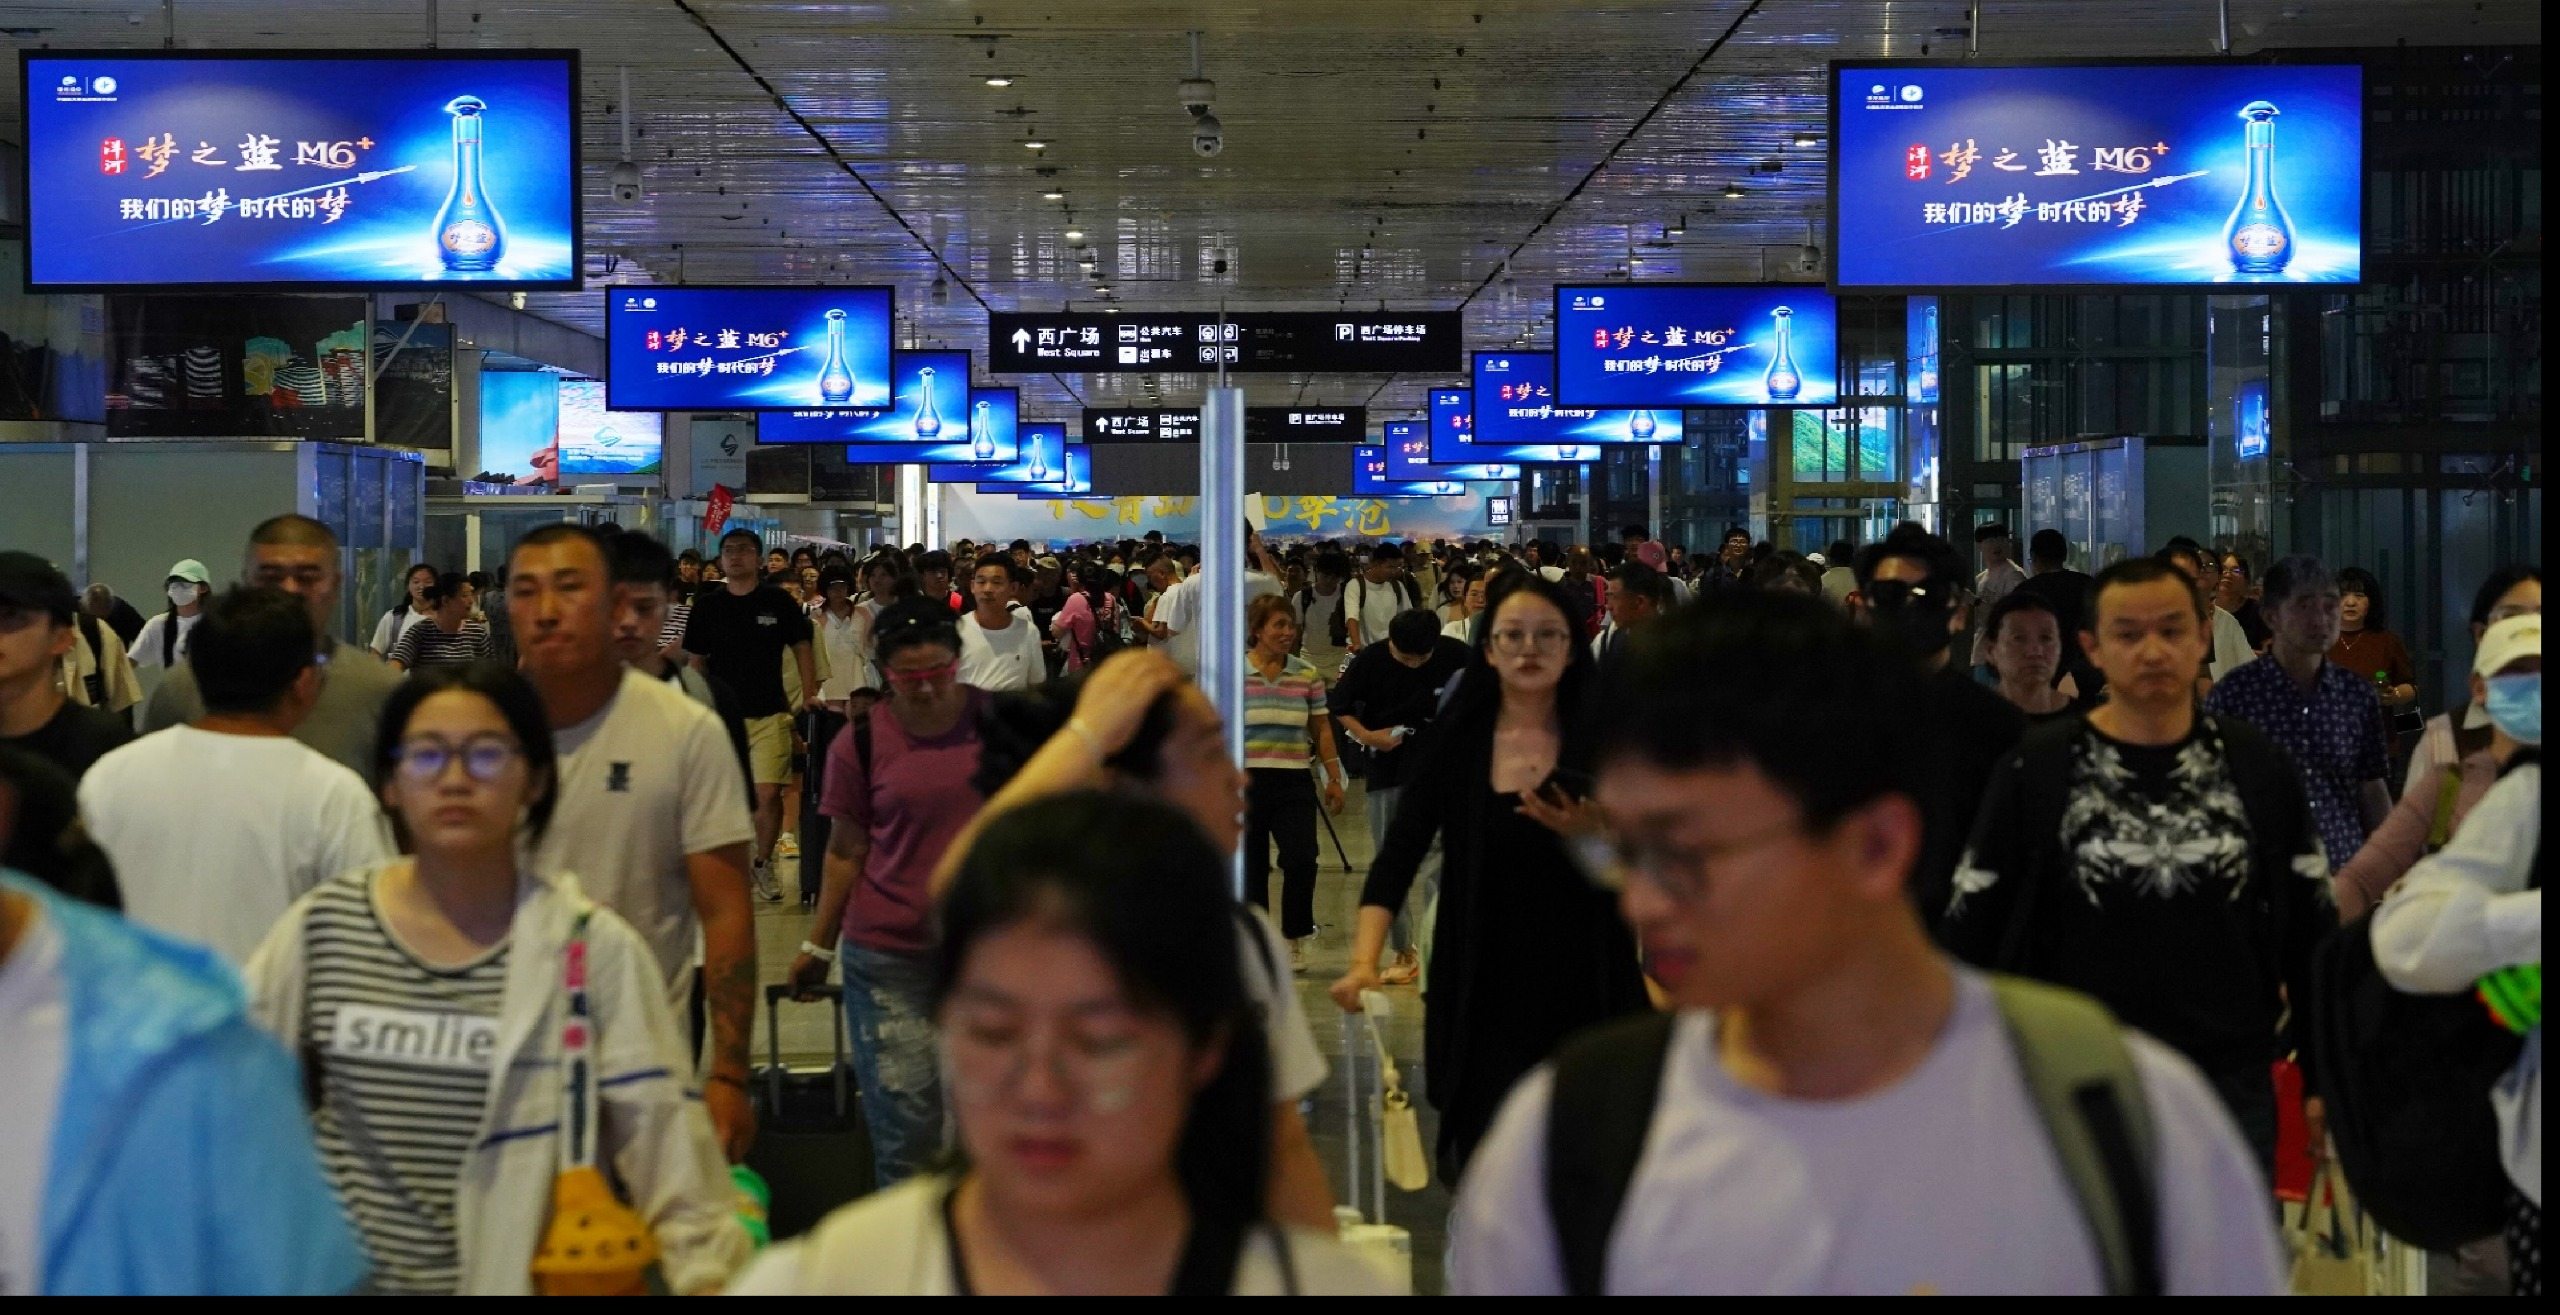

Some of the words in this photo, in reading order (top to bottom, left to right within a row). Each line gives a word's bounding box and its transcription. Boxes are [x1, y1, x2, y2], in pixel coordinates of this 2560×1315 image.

[134, 132, 283, 179] 梦之蓝
[1938, 138, 2080, 185] 梦之蓝
[119, 187, 233, 226] 我们的梦
[240, 186, 352, 225] 时代的梦
[1923, 191, 2031, 230] 我们的梦
[2038, 190, 2148, 228] 时代的梦
[1037, 327, 1100, 346] 西广场
[1064, 348, 1100, 359] Square
[1111, 416, 1149, 427] 西广场
